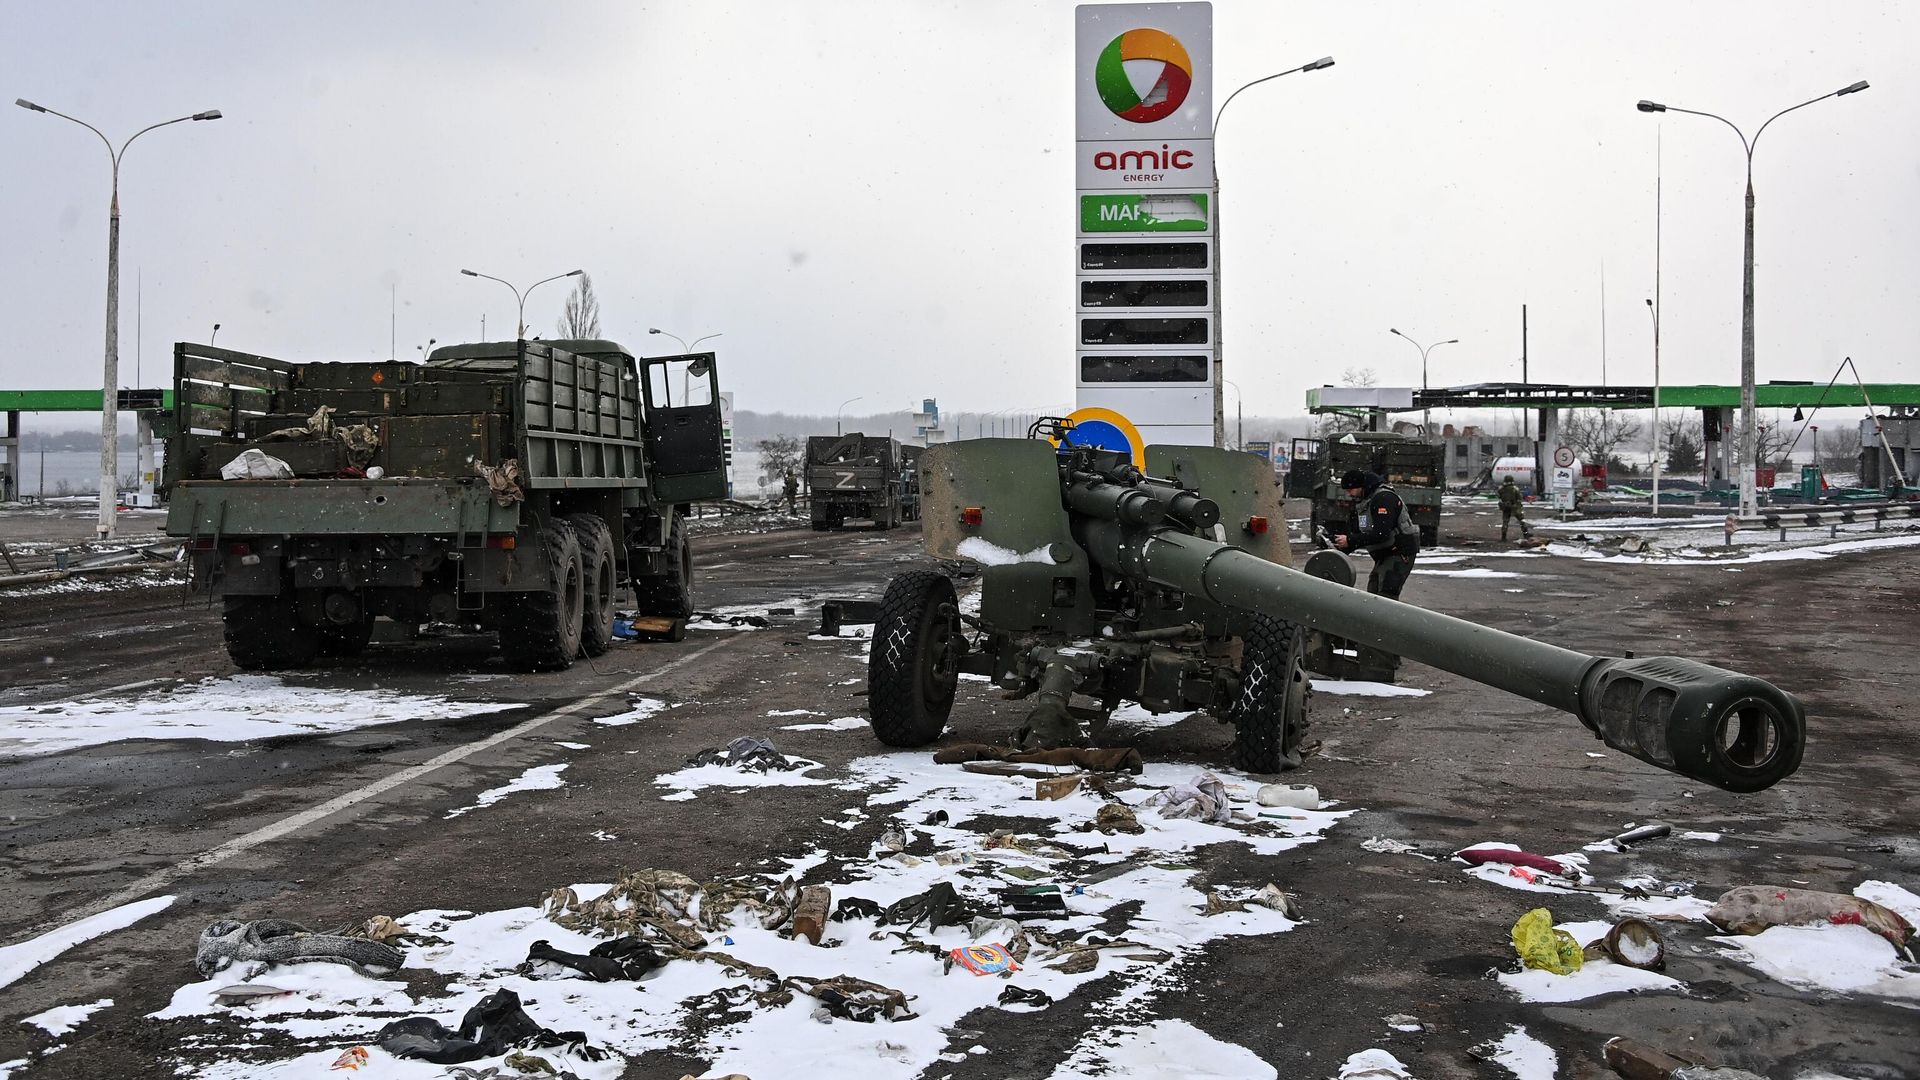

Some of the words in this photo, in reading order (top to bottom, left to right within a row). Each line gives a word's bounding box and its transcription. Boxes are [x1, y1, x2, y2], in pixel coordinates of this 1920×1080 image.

[1094, 144, 1194, 171] amic
[1123, 174, 1165, 182] ENERGY
[1561, 453, 1569, 462] 5
[835, 471, 856, 489] Z
